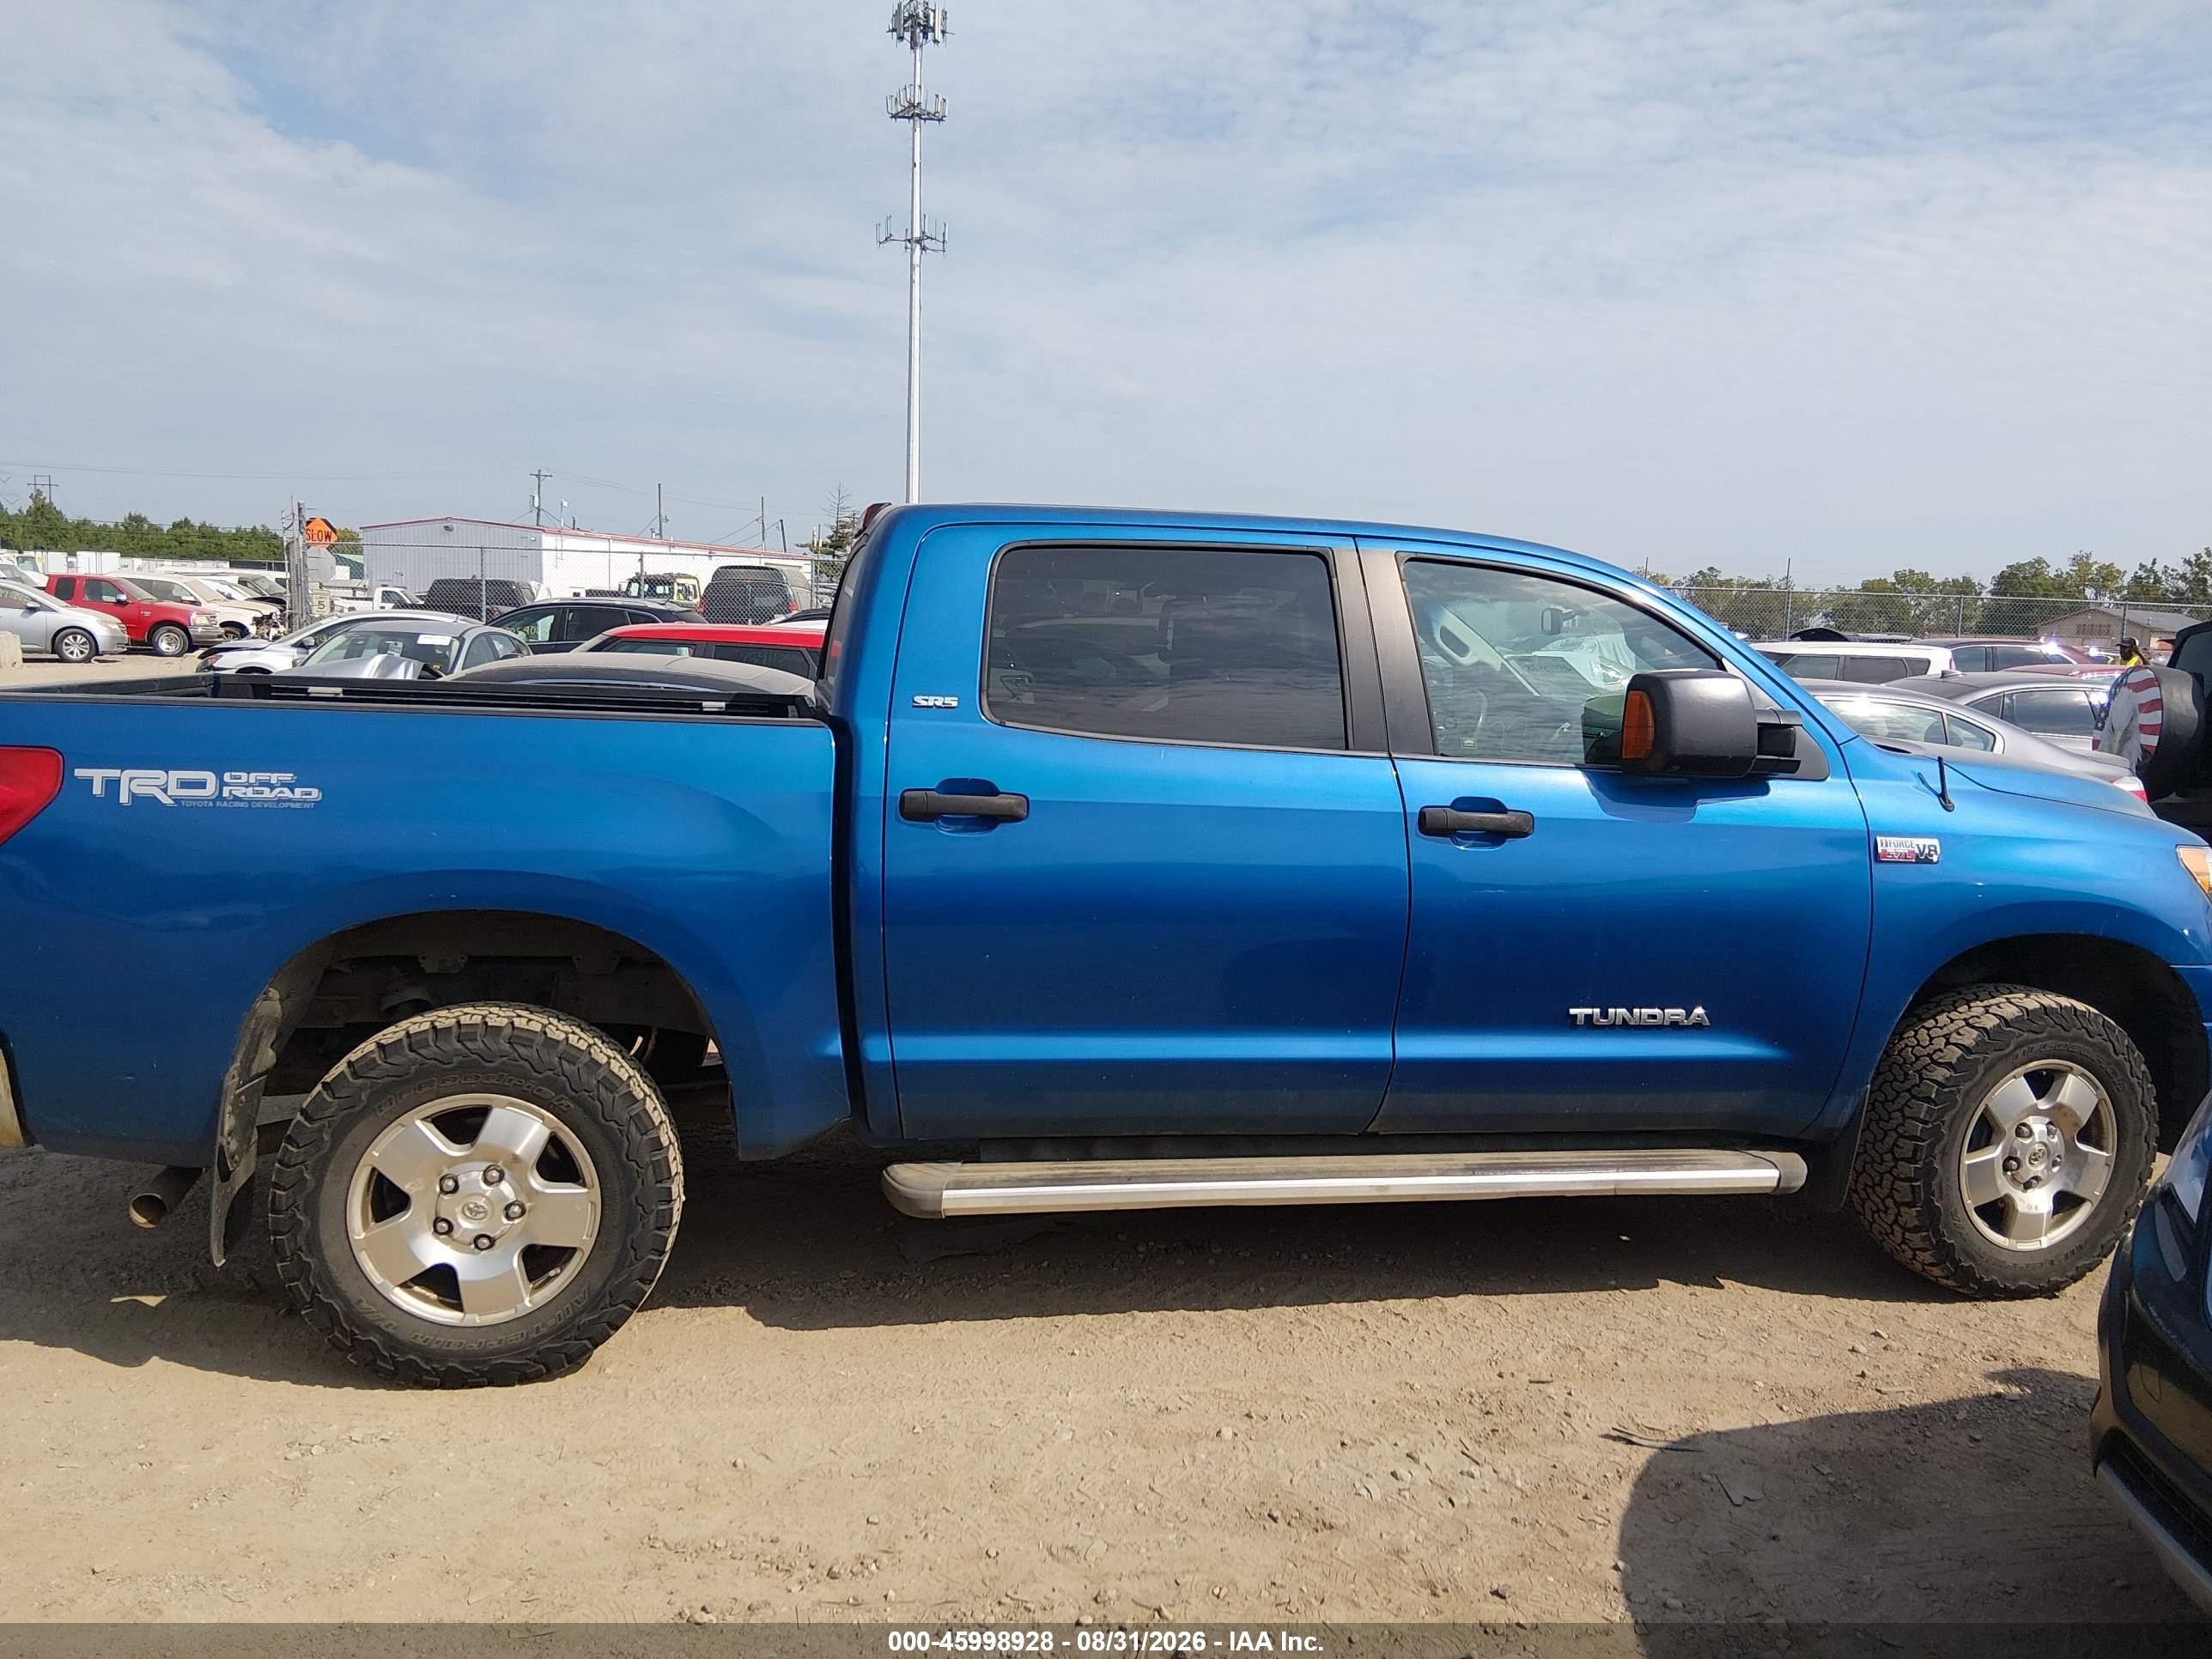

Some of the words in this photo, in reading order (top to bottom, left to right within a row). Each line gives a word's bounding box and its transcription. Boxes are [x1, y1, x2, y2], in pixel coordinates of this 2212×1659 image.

[306, 528, 332, 543] SLOW
[318, 600, 325, 610] 5
[913, 696, 959, 708] SR5
[222, 771, 297, 784] OFF
[74, 769, 219, 805] TRD
[222, 786, 322, 801] ROAD
[181, 799, 214, 808] TOYOTA
[216, 800, 249, 809] RACING
[252, 801, 316, 810] DEVELOPMENT
[1915, 843, 1938, 860] V8
[1569, 1006, 1711, 1026] TUNDRA
